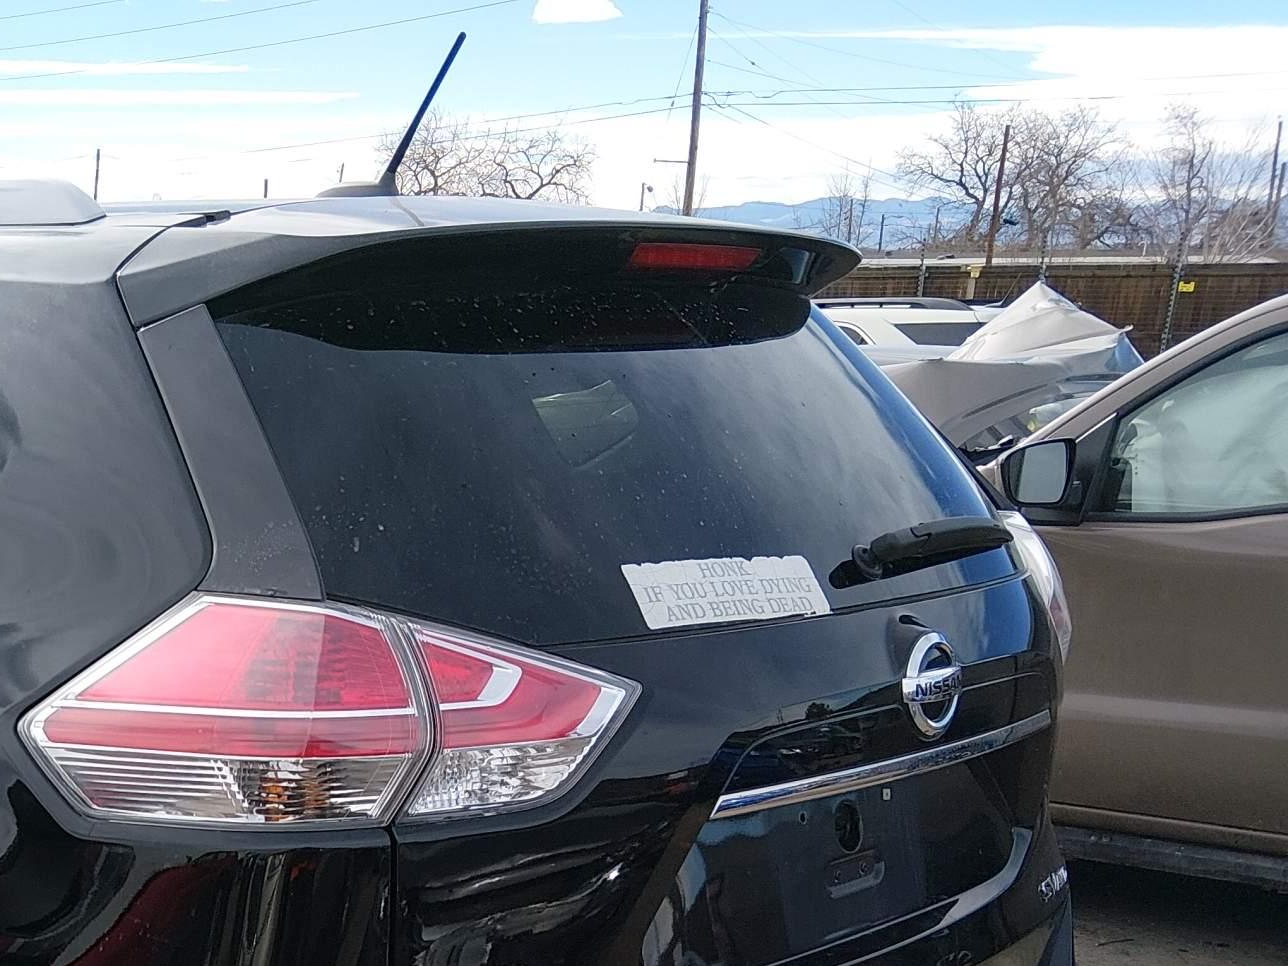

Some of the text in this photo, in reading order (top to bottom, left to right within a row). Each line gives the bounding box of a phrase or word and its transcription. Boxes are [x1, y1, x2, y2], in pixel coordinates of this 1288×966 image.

[697, 561, 753, 579] HONK
[643, 576, 813, 603] IF YOU LOVE DYING
[667, 596, 814, 622] AND BEING DEAD
[915, 674, 962, 698] NISSAN
